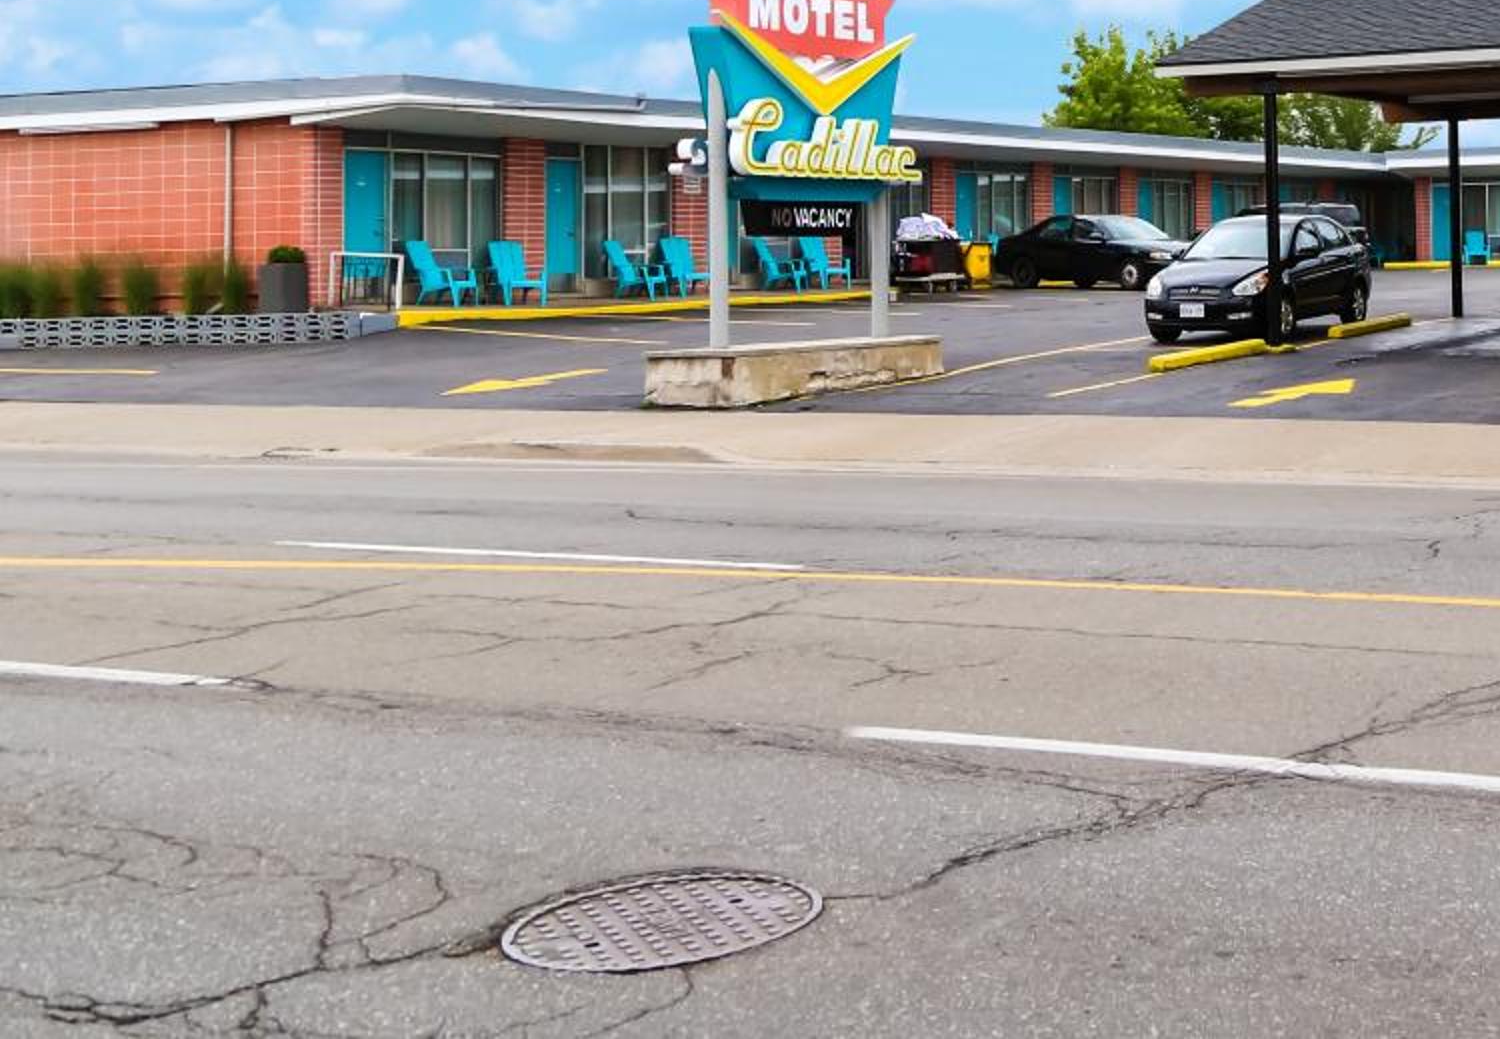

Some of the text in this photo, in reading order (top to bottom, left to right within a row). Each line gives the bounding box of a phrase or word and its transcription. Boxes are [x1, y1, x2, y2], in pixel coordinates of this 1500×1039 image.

[730, 98, 922, 183] Cadillac
[771, 207, 852, 228] NO VACANCY
